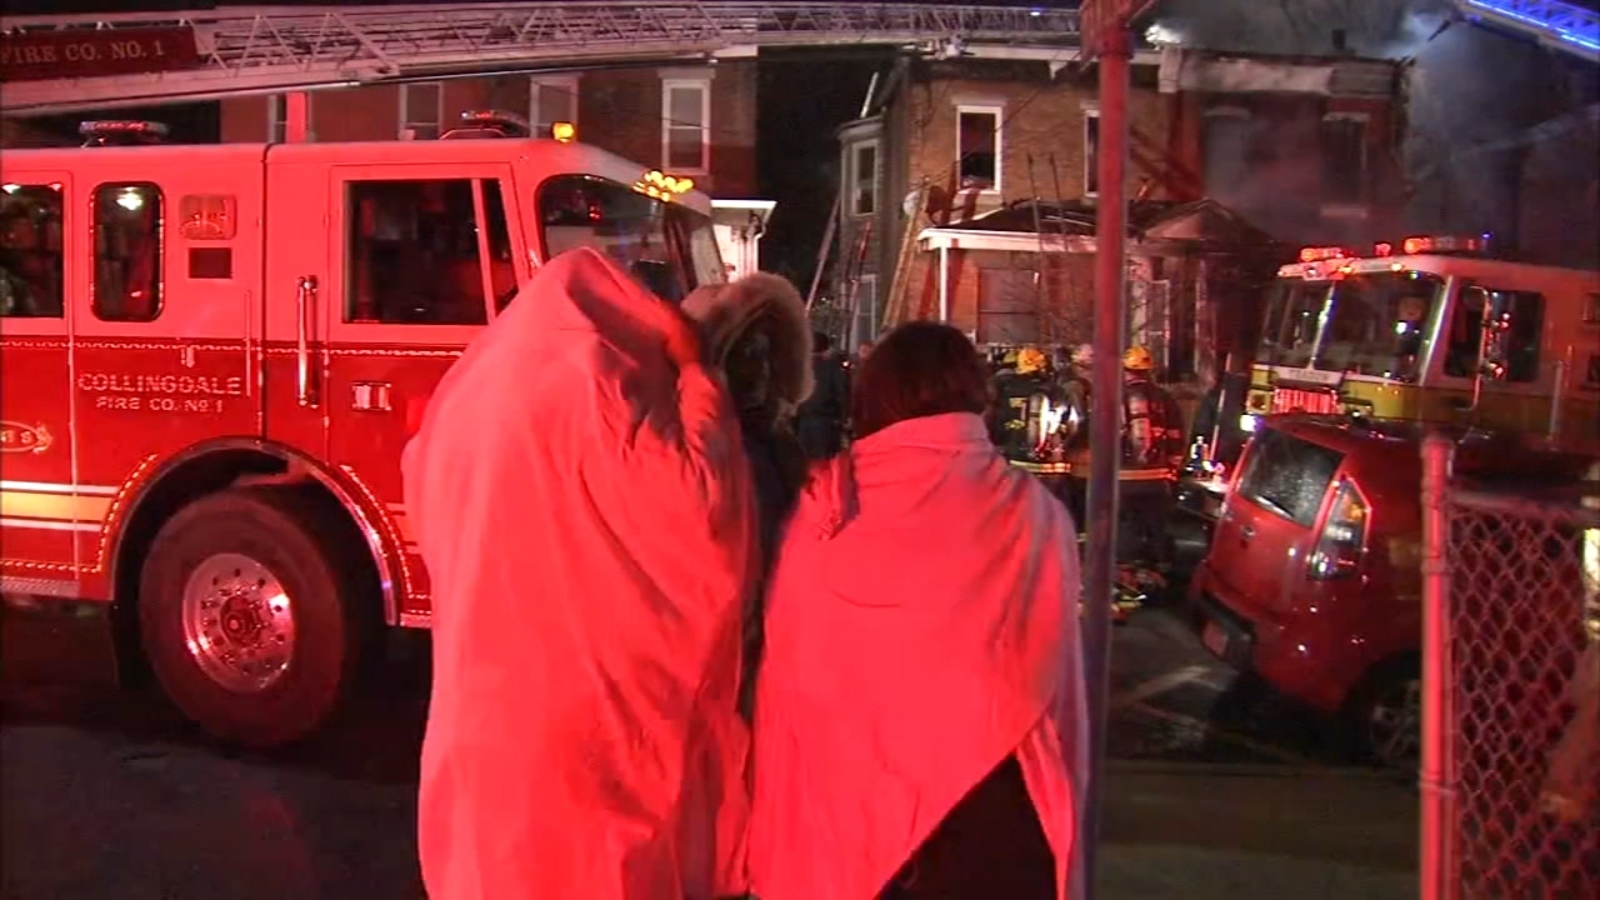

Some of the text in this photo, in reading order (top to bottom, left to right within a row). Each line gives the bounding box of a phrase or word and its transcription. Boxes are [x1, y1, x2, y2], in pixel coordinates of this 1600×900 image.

[2, 39, 165, 64] FIRE CO. NO. 1
[78, 373, 241, 395] COLLINGDALE
[96, 396, 141, 410] FIRE
[215, 399, 223, 413] 1
